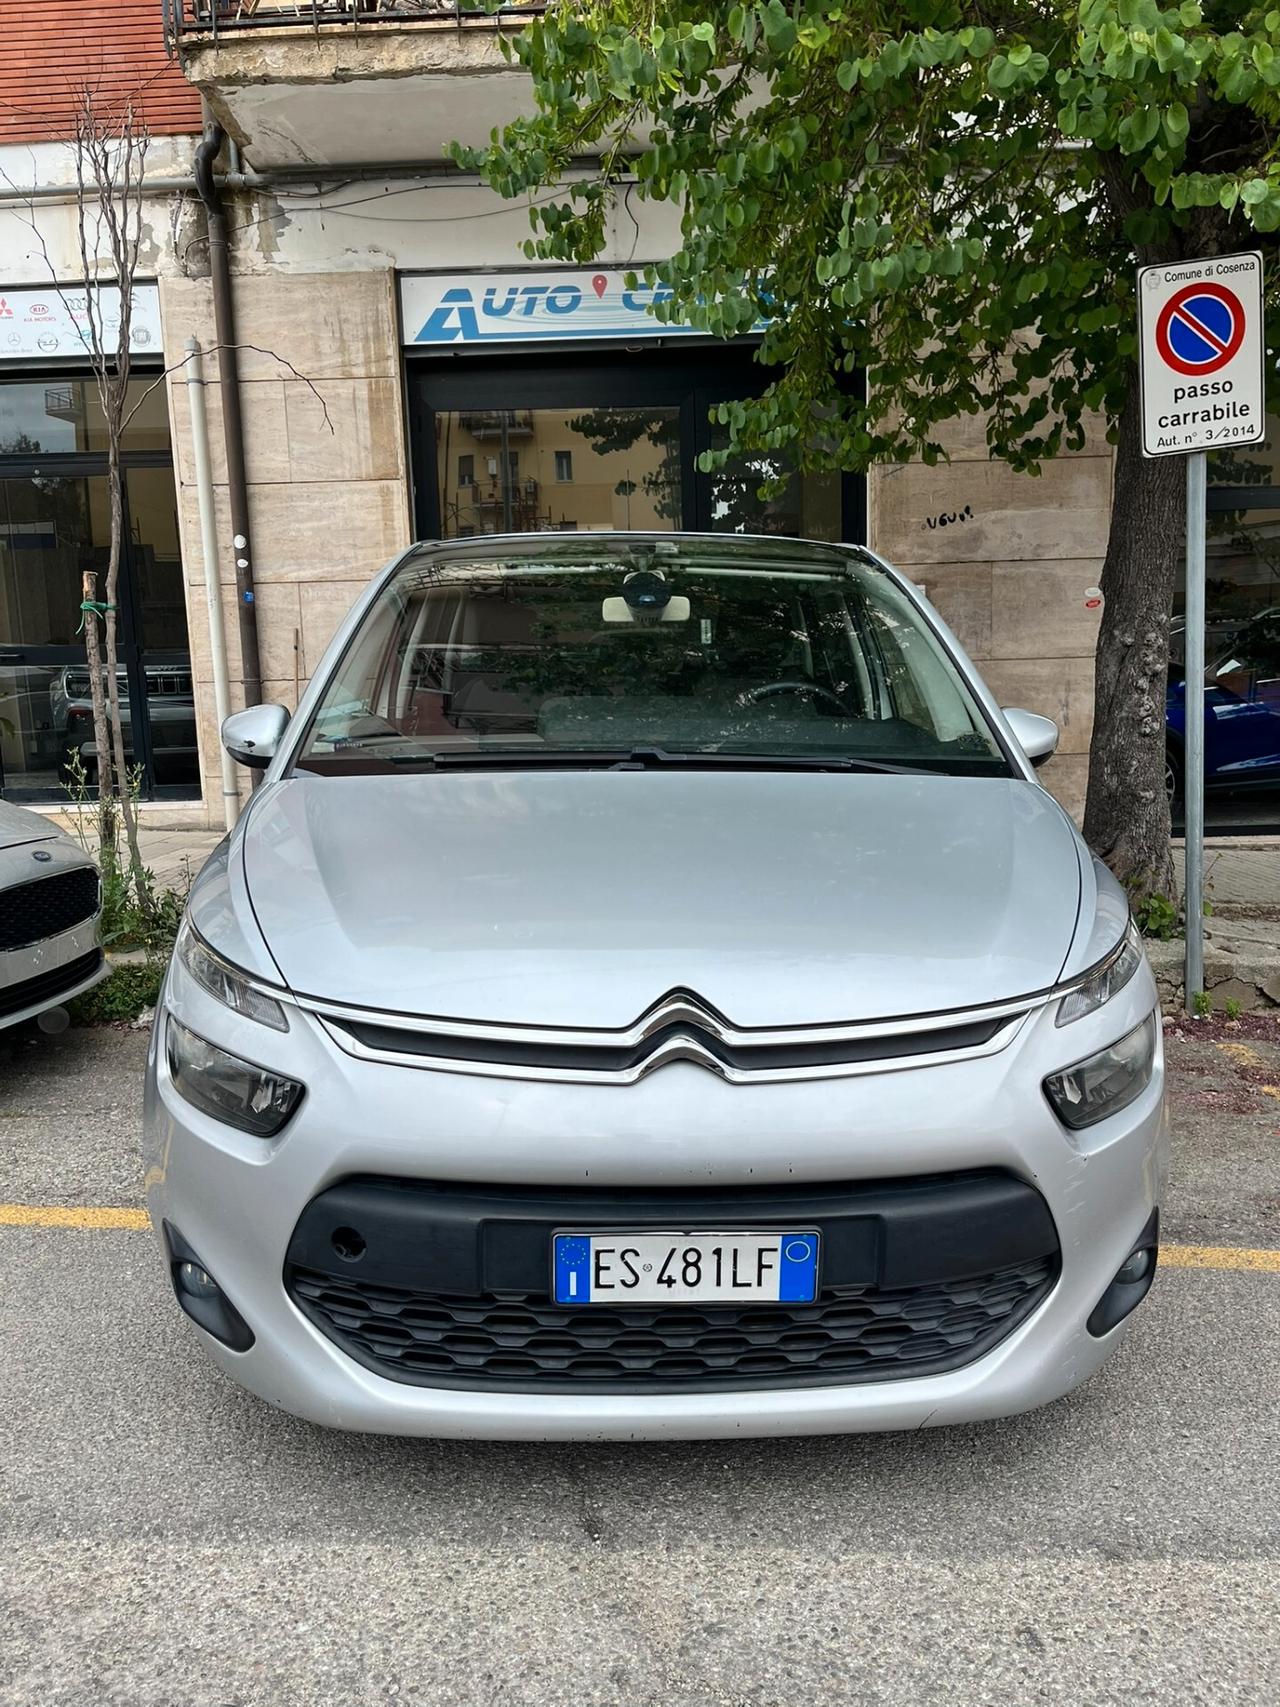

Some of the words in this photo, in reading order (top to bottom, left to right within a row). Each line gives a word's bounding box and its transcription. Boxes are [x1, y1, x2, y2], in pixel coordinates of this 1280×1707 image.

[1164, 268, 1202, 283] Comune
[1205, 265, 1214, 277] di
[1216, 261, 1255, 275] Cosenza
[414, 285, 582, 341] AUTO
[1174, 380, 1234, 403] passo
[1158, 401, 1250, 429] carrabile
[1157, 436, 1181, 448] Aut.
[1205, 424, 1255, 441] 3/2014
[594, 1247, 641, 1289] ES
[656, 1247, 779, 1289] 481LF
